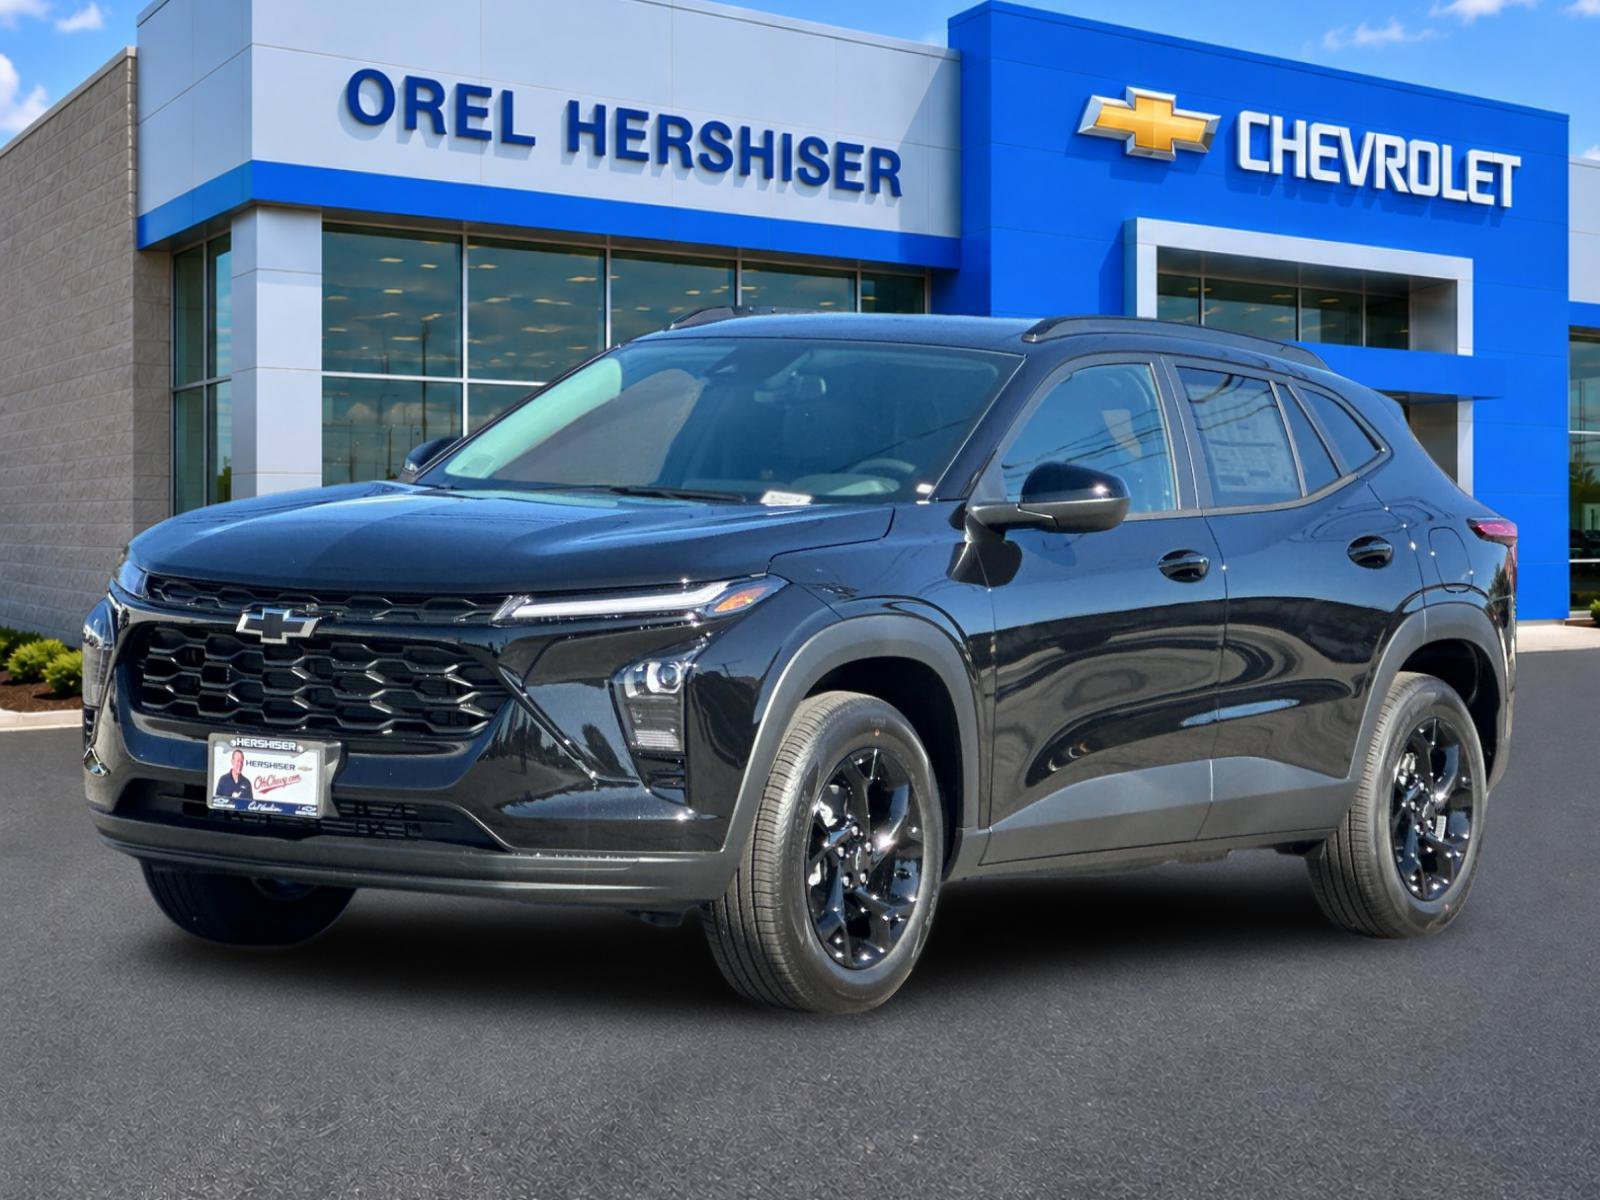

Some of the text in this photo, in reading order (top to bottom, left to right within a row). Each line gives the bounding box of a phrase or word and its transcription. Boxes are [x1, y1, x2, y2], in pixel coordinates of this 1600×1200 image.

[345, 68, 903, 198] OREL HERSHISER
[1236, 110, 1522, 208] CHEVROLET
[236, 738, 297, 751] HERSHISER
[246, 760, 296, 771] HERSHISER
